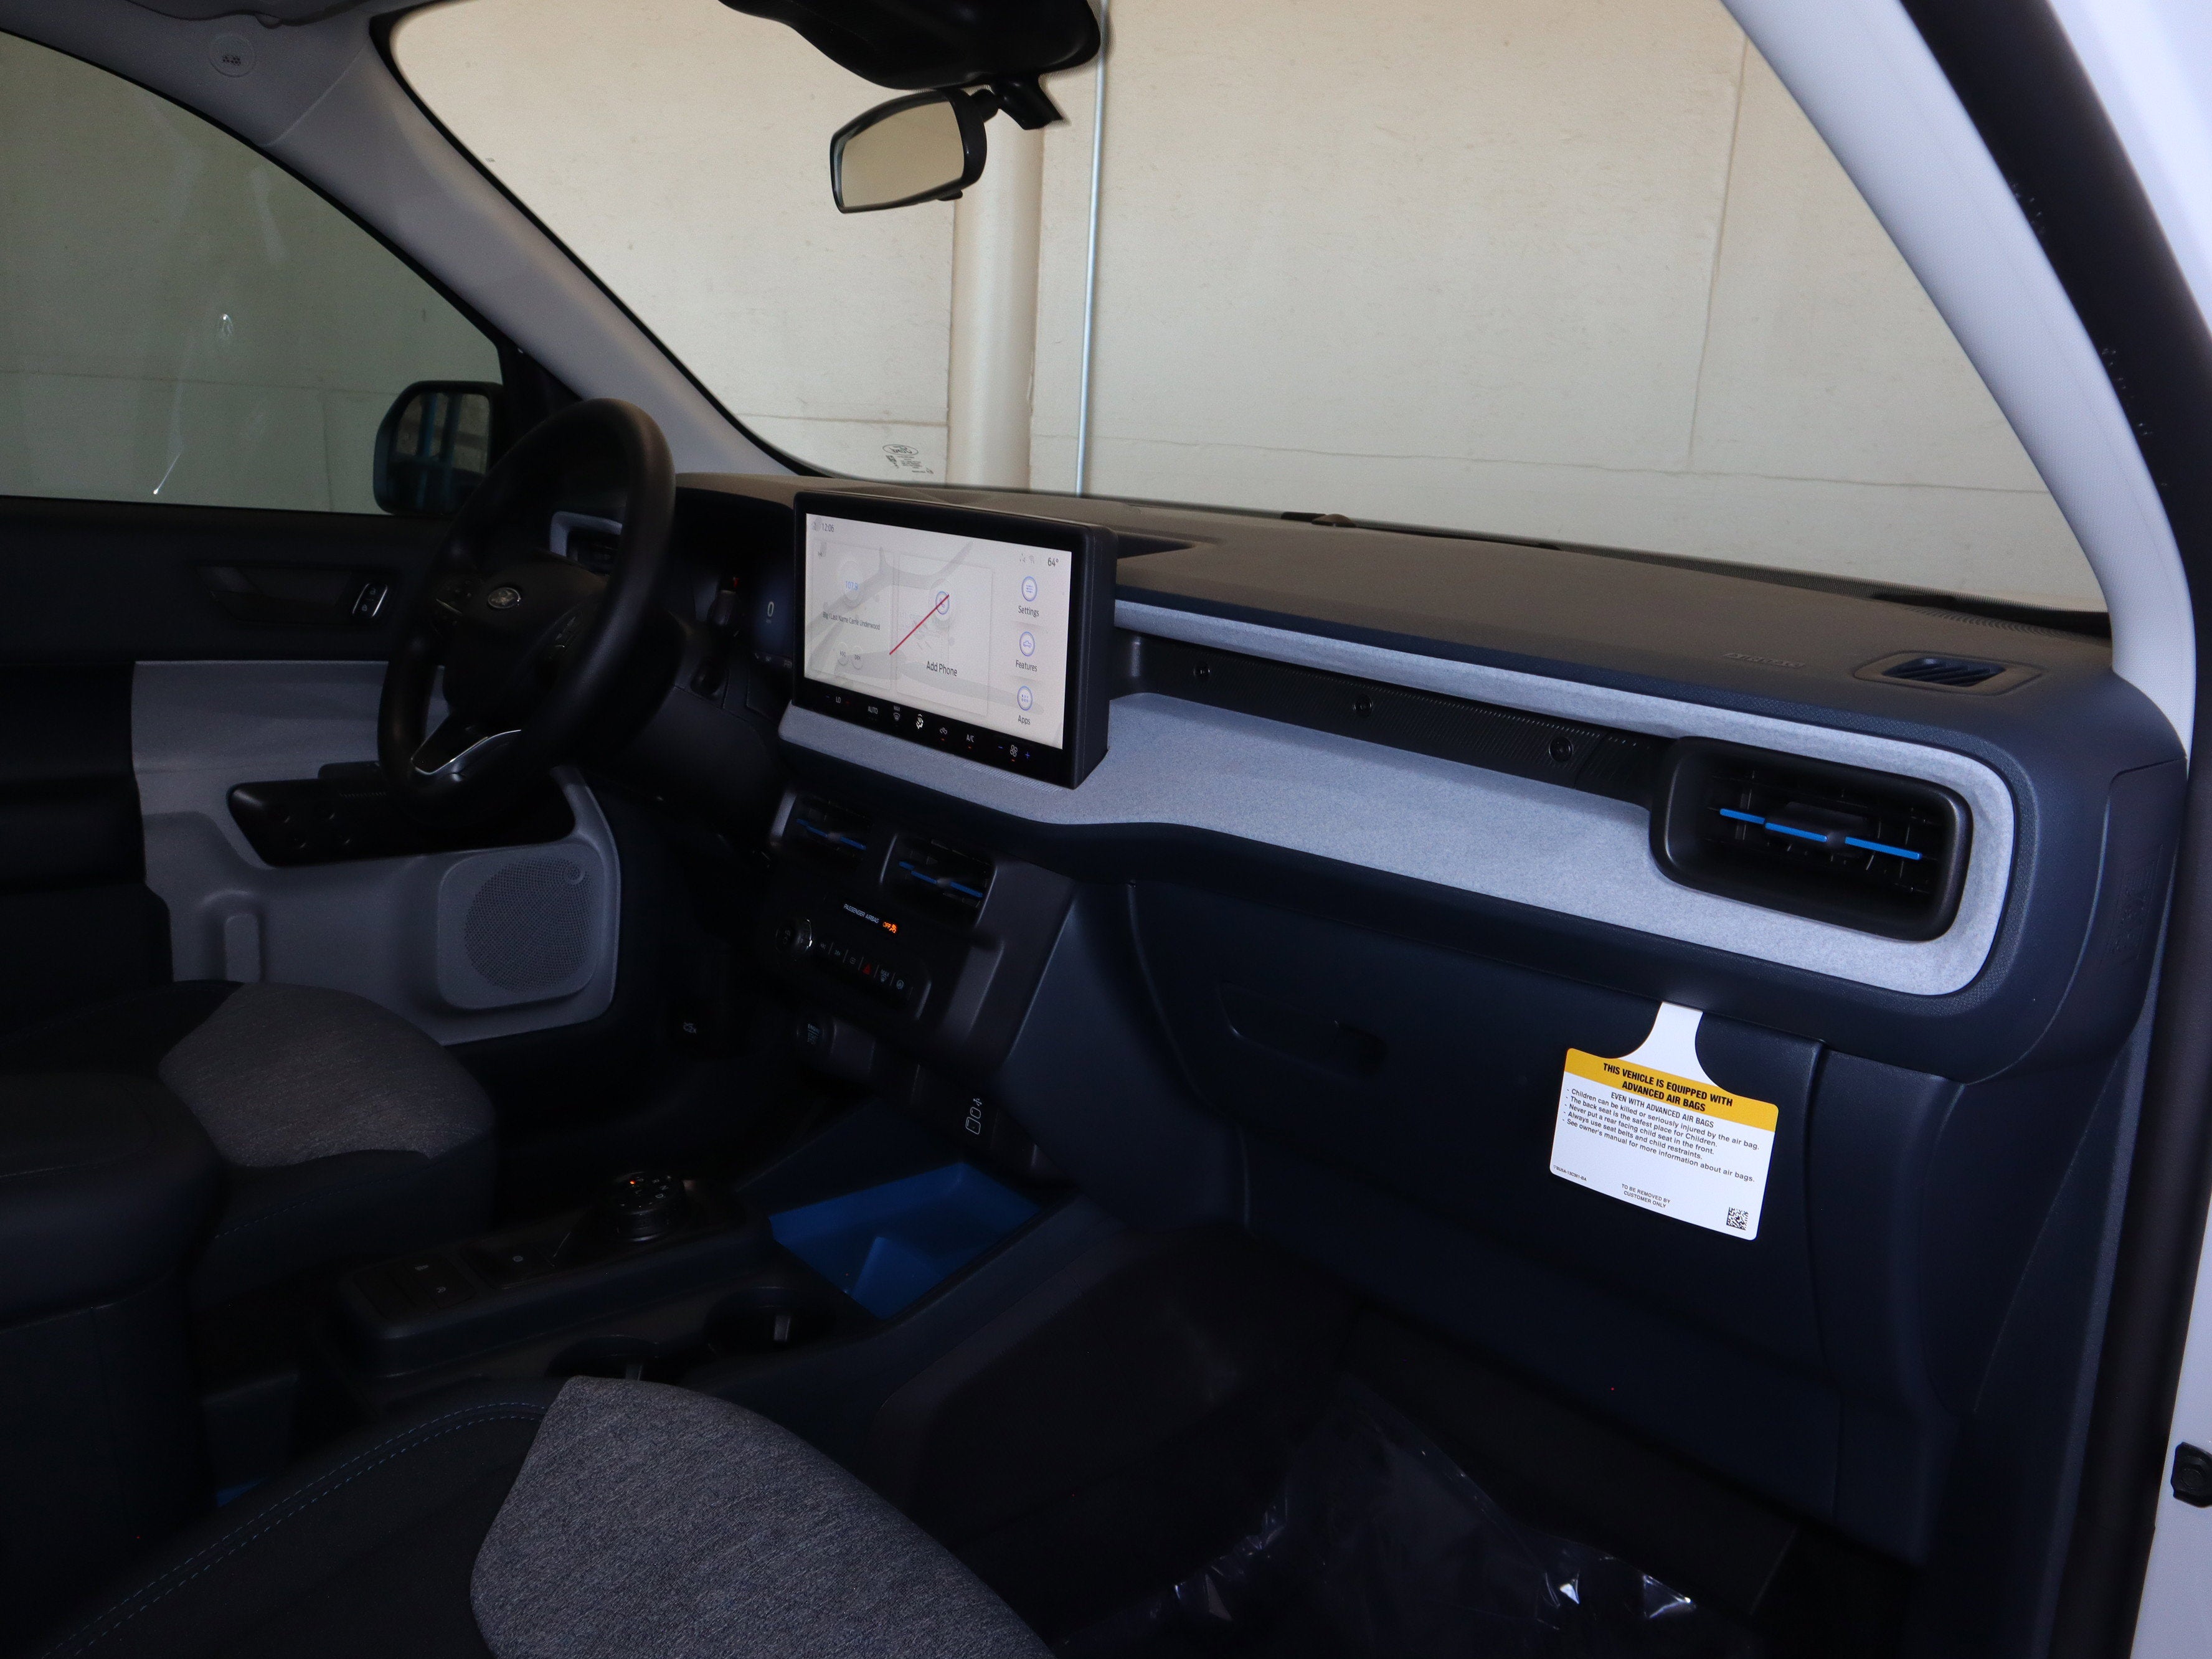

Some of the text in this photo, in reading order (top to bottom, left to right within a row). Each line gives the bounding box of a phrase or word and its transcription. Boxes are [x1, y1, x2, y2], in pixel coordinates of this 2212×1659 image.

[821, 523, 834, 532] 12:06
[1018, 605, 1039, 618] Settings
[927, 660, 958, 677] Add Phone
[1015, 659, 1037, 672] Features
[867, 706, 879, 715] AUTO
[1017, 714, 1031, 726] Apps
[1603, 1062, 1733, 1107] THIS VEHICLE IS EQUIPPED WITH
[1622, 1080, 1706, 1112] ADVANCED AIR BAGS
[1571, 1088, 1597, 1102] Children
[1597, 1099, 1609, 1107] can
[1610, 1101, 1619, 1109] be
[1620, 1104, 1638, 1115] killed
[1647, 1114, 1679, 1129] seriously
[1680, 1123, 1706, 1135] injured
[1707, 1130, 1717, 1140] by
[1718, 1133, 1730, 1142] the
[1743, 1140, 1759, 1151] bag.
[1571, 1095, 1718, 1147] The back seat is the safest place for Children.
[1610, 1092, 1714, 1128] EVEN WITH ADVANCED AIR BAGS
[1567, 1111, 1703, 1160] Always use seat belts and child restraints.
[1569, 1103, 1587, 1114] Never
[1587, 1110, 1598, 1119] put
[1604, 1117, 1617, 1125] rear
[1618, 1120, 1638, 1133] facing
[1639, 1128, 1657, 1138] child
[1657, 1133, 1673, 1143] seat
[1674, 1137, 1681, 1145] in
[1682, 1140, 1694, 1149] the
[1695, 1143, 1714, 1155] front.
[1566, 1118, 1578, 1128] See
[1579, 1124, 1603, 1137] owner's
[1604, 1133, 1628, 1145] manual
[1628, 1140, 1638, 1148] for
[1639, 1144, 1657, 1154] more
[1658, 1149, 1699, 1167] information
[1699, 1163, 1721, 1173] about
[1734, 1171, 1755, 1182] bags.
[1624, 1190, 1666, 1208] CUSTOMER ONLY
[1637, 1189, 1663, 1201] REMOVED
